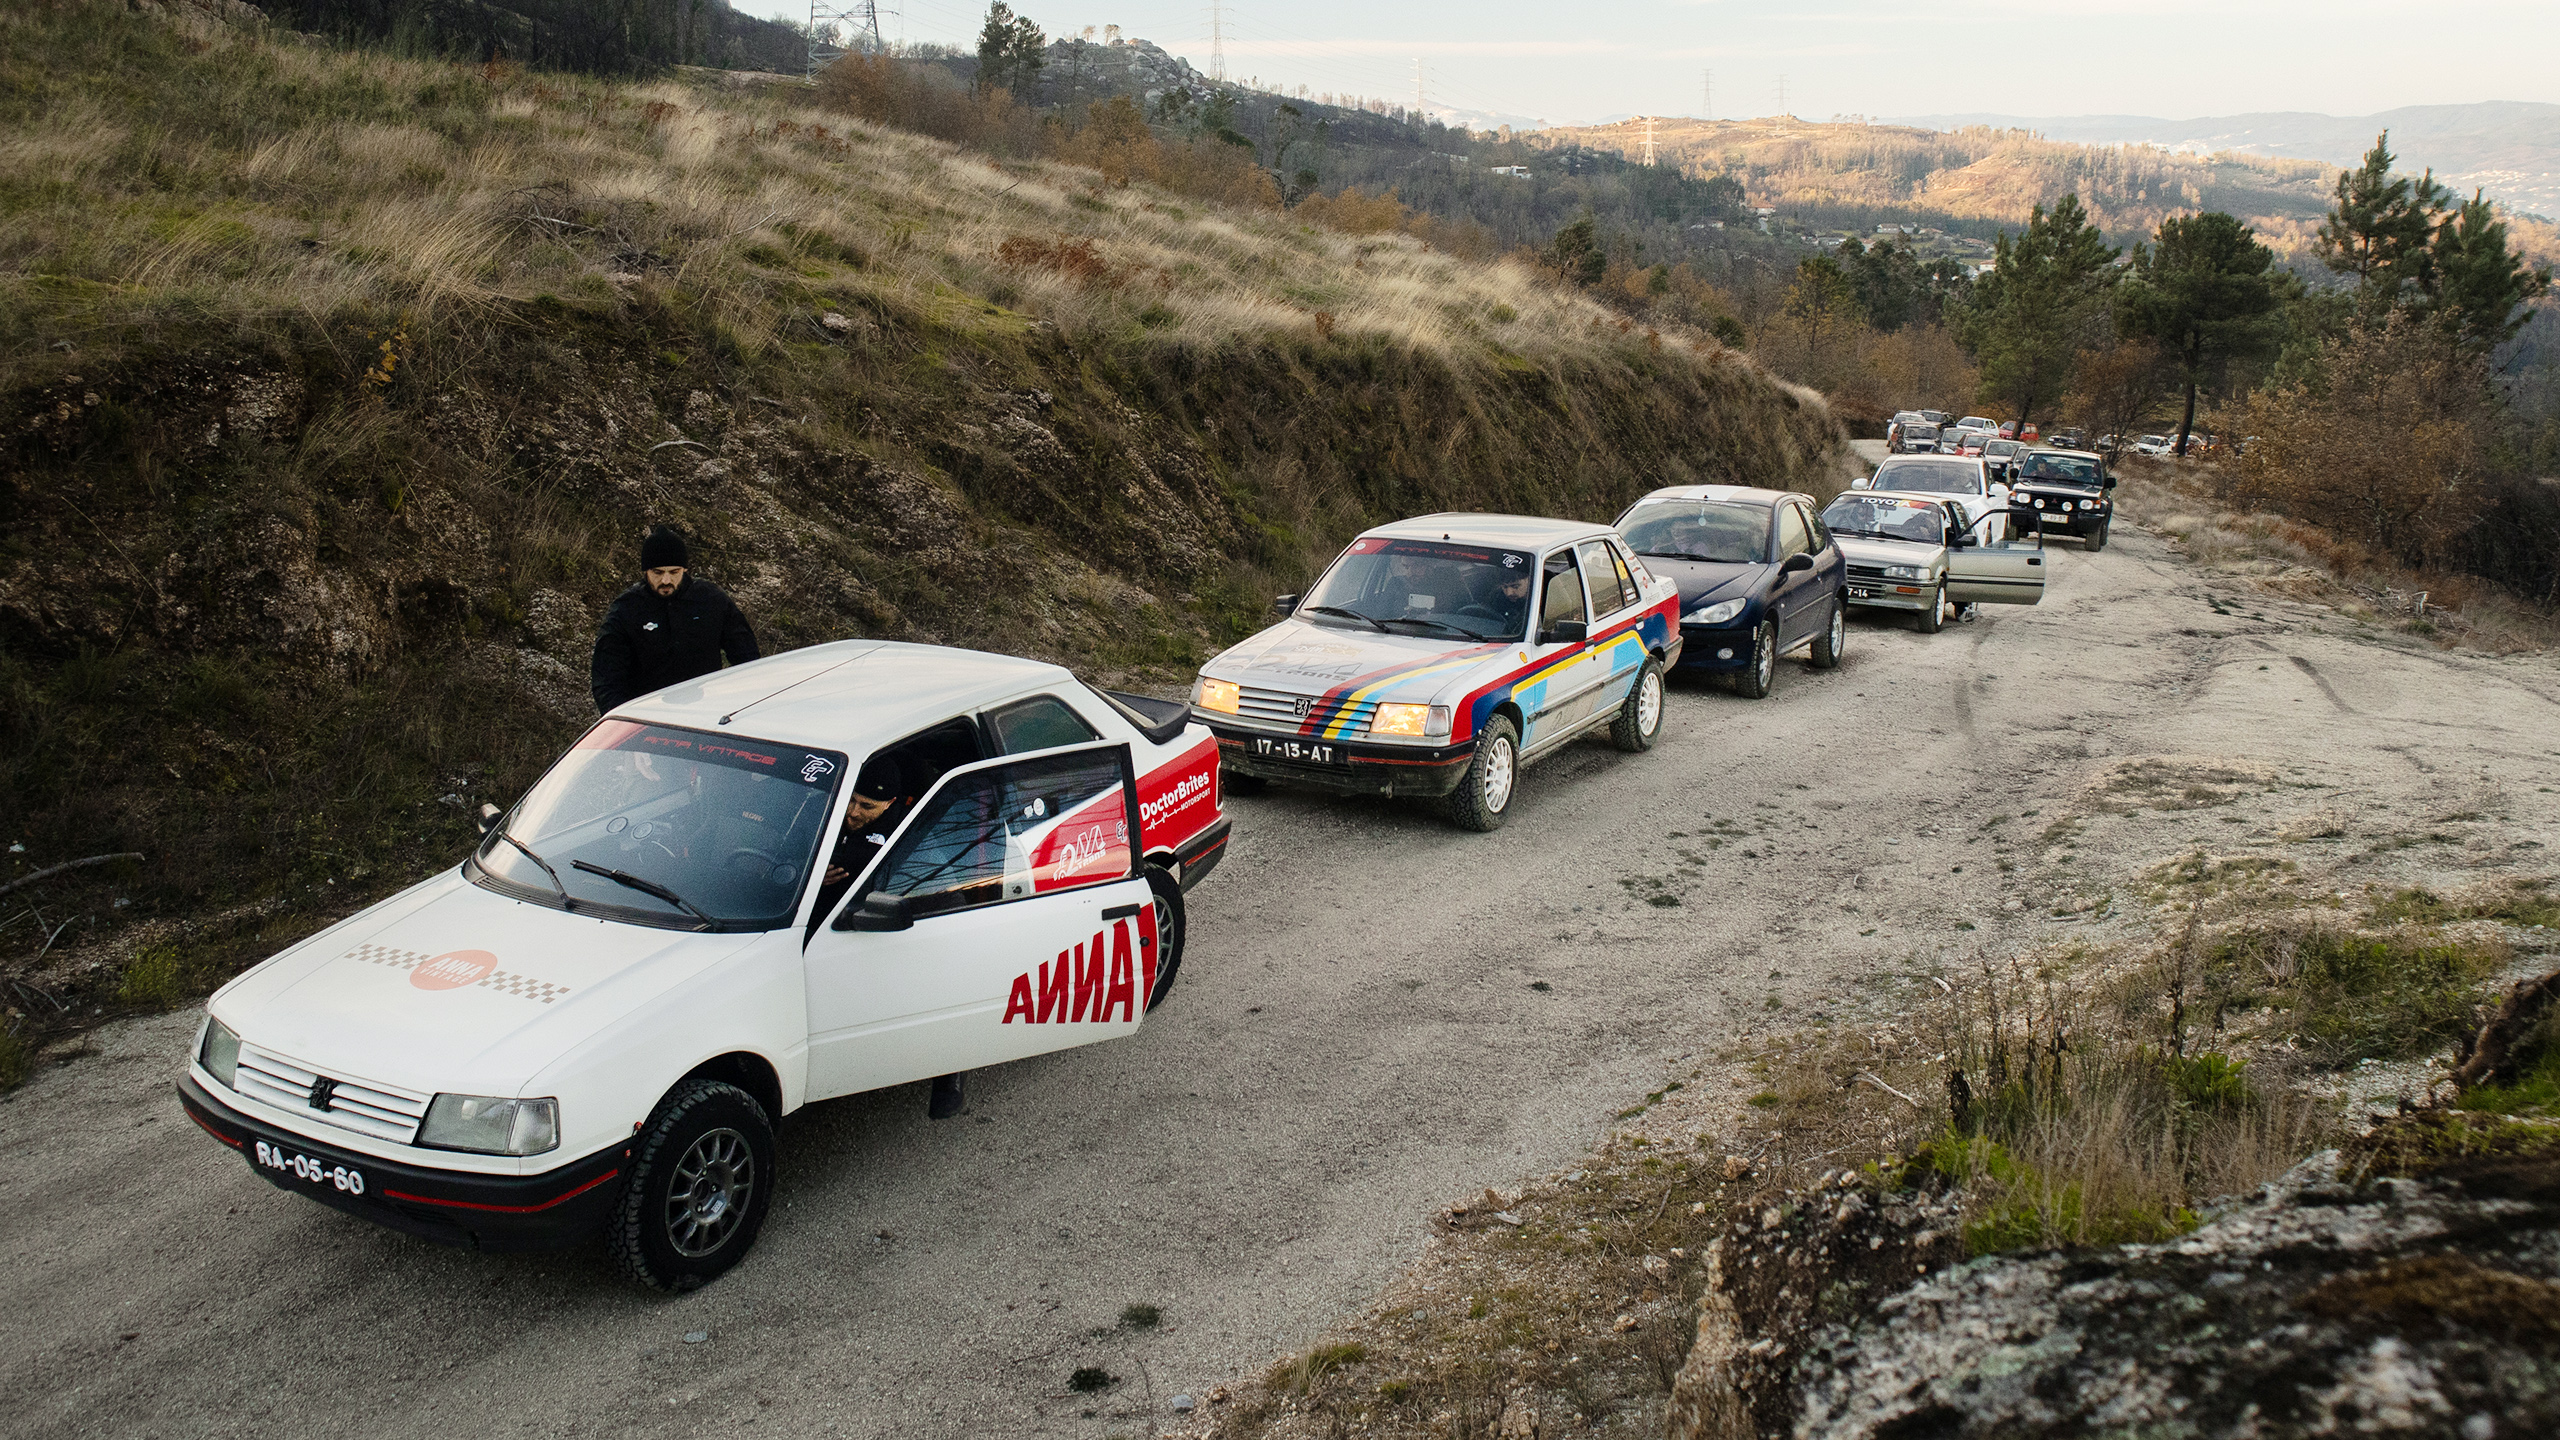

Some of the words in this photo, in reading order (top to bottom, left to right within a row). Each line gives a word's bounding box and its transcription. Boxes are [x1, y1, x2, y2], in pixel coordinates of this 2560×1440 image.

[1860, 497, 1910, 507] TOYOTA
[698, 744, 777, 766] VINTAGE
[1256, 739, 1332, 762] 17-13-AT
[1140, 771, 1209, 821] DoctorBrites
[1180, 788, 1211, 811] MOTORSPORT
[419, 967, 470, 985] VINTAGE
[428, 957, 486, 979] ANNA
[255, 1140, 365, 1195] RA-05-60
